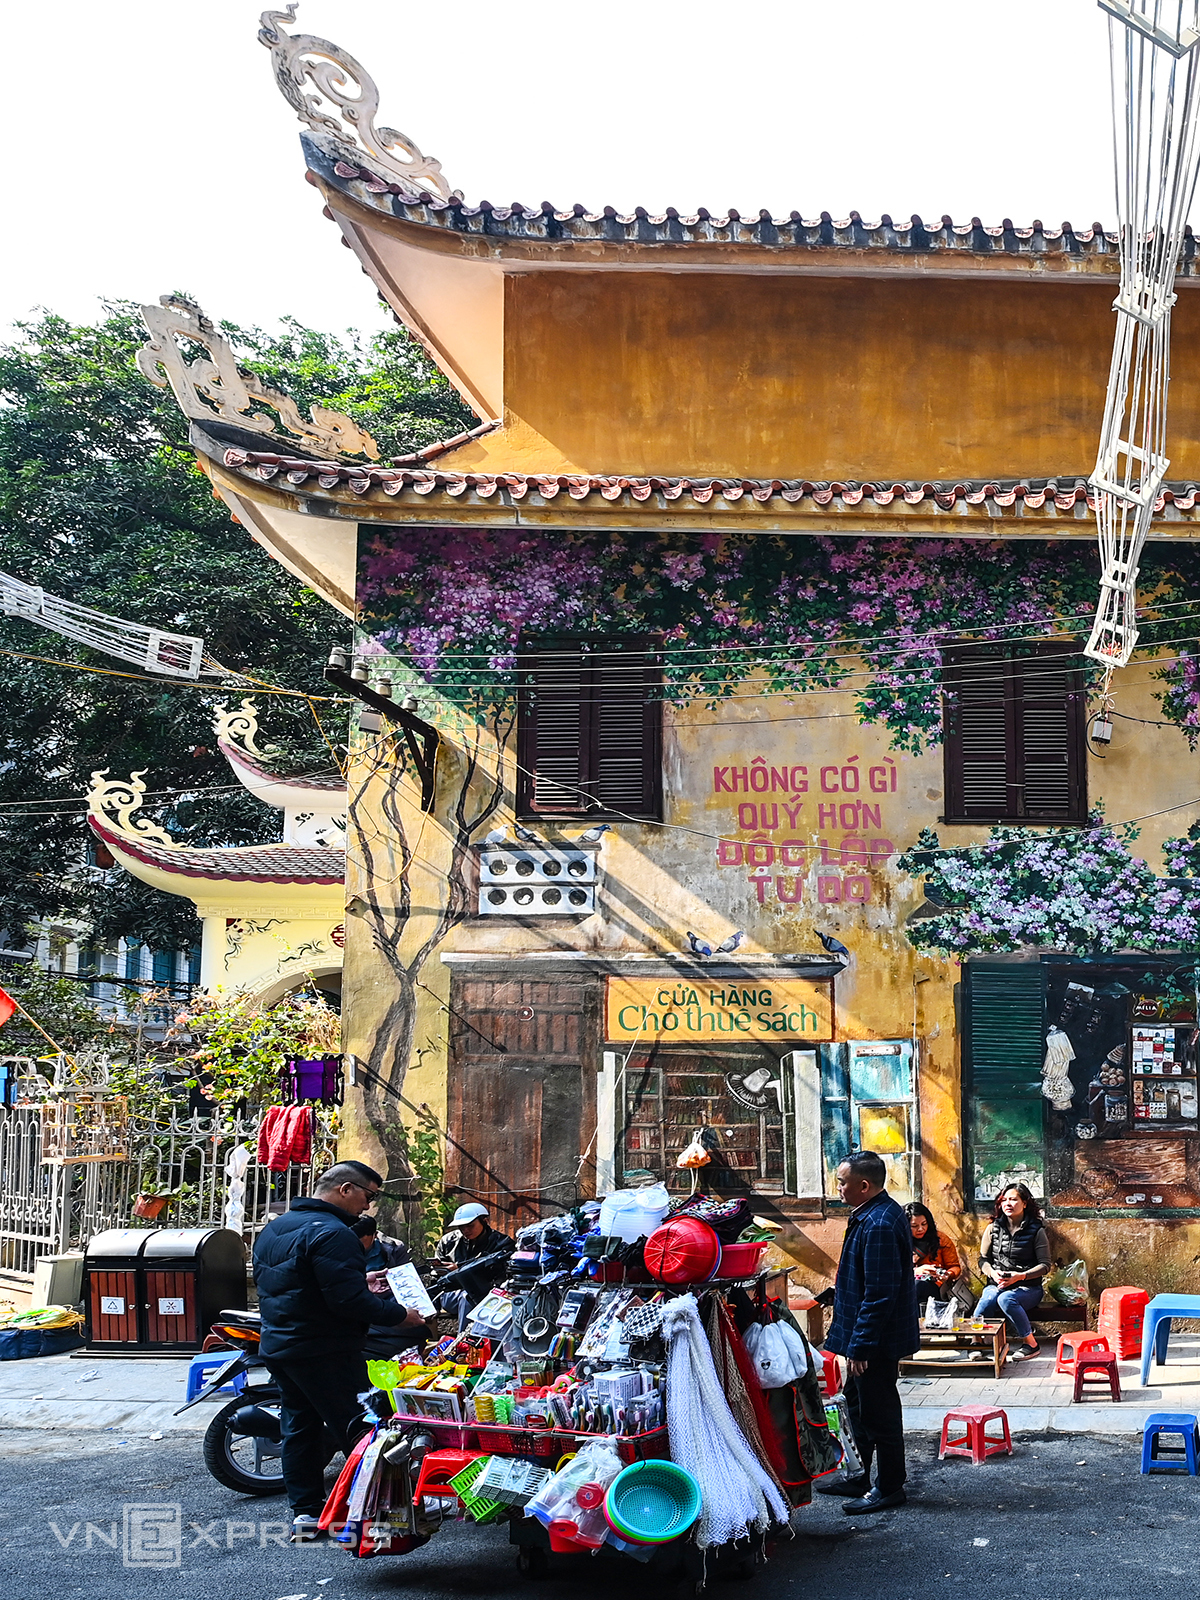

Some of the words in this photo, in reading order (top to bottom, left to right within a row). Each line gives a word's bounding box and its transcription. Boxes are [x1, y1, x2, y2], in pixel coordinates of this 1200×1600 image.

[714, 755, 809, 793] KHÔNG
[820, 754, 860, 793] CÓ
[869, 755, 897, 793] GÌ
[738, 794, 801, 830] QUÝ
[819, 799, 882, 830] HƠN
[716, 833, 806, 872] ĐỘC
[817, 875, 871, 904] DO
[658, 984, 700, 1006] CỬA
[710, 984, 772, 1007] HÀNG
[618, 1005, 679, 1032] Cho
[686, 1006, 752, 1032] thuê
[757, 1004, 818, 1032] sách
